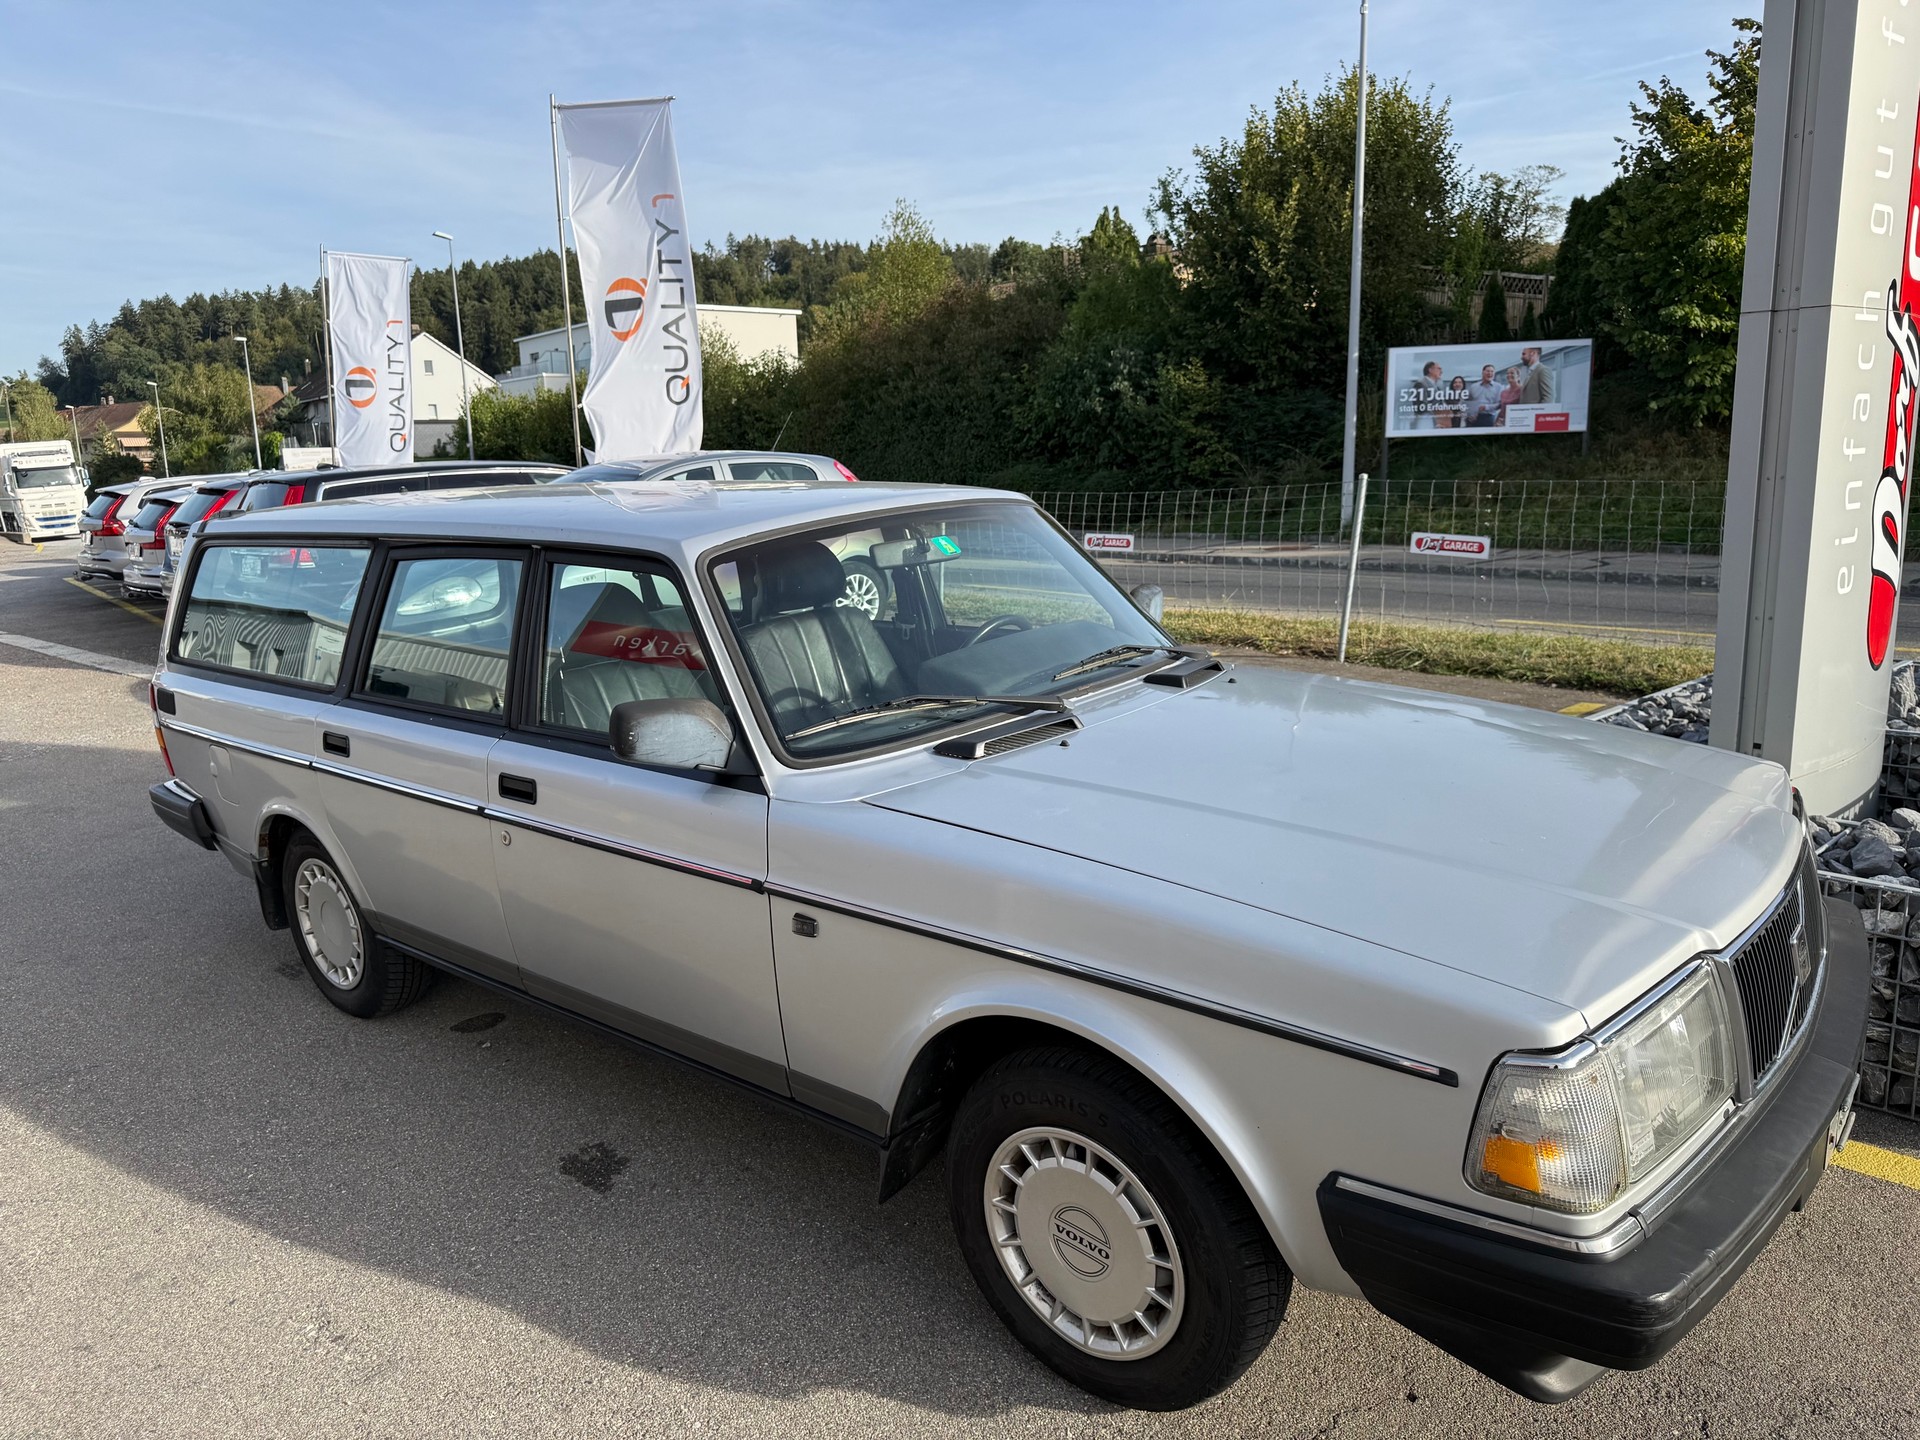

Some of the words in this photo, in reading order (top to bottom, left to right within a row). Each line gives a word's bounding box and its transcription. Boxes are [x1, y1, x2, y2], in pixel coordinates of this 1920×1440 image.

[652, 193, 675, 208] 1
[654, 218, 690, 406] QUALITY
[386, 319, 404, 328] 1
[1835, 290, 1881, 595] einfach
[1870, 98, 1899, 237] gut
[386, 334, 407, 453] QUALITY
[1399, 388, 1424, 402] 521
[1426, 387, 1470, 401] Jahre
[1419, 404, 1426, 412] 0
[1104, 539, 1128, 547] GARAGE
[1443, 541, 1480, 552] GARAGE
[1001, 1090, 1090, 1118] POLARIS
[1054, 1222, 1111, 1261] VOLVO
